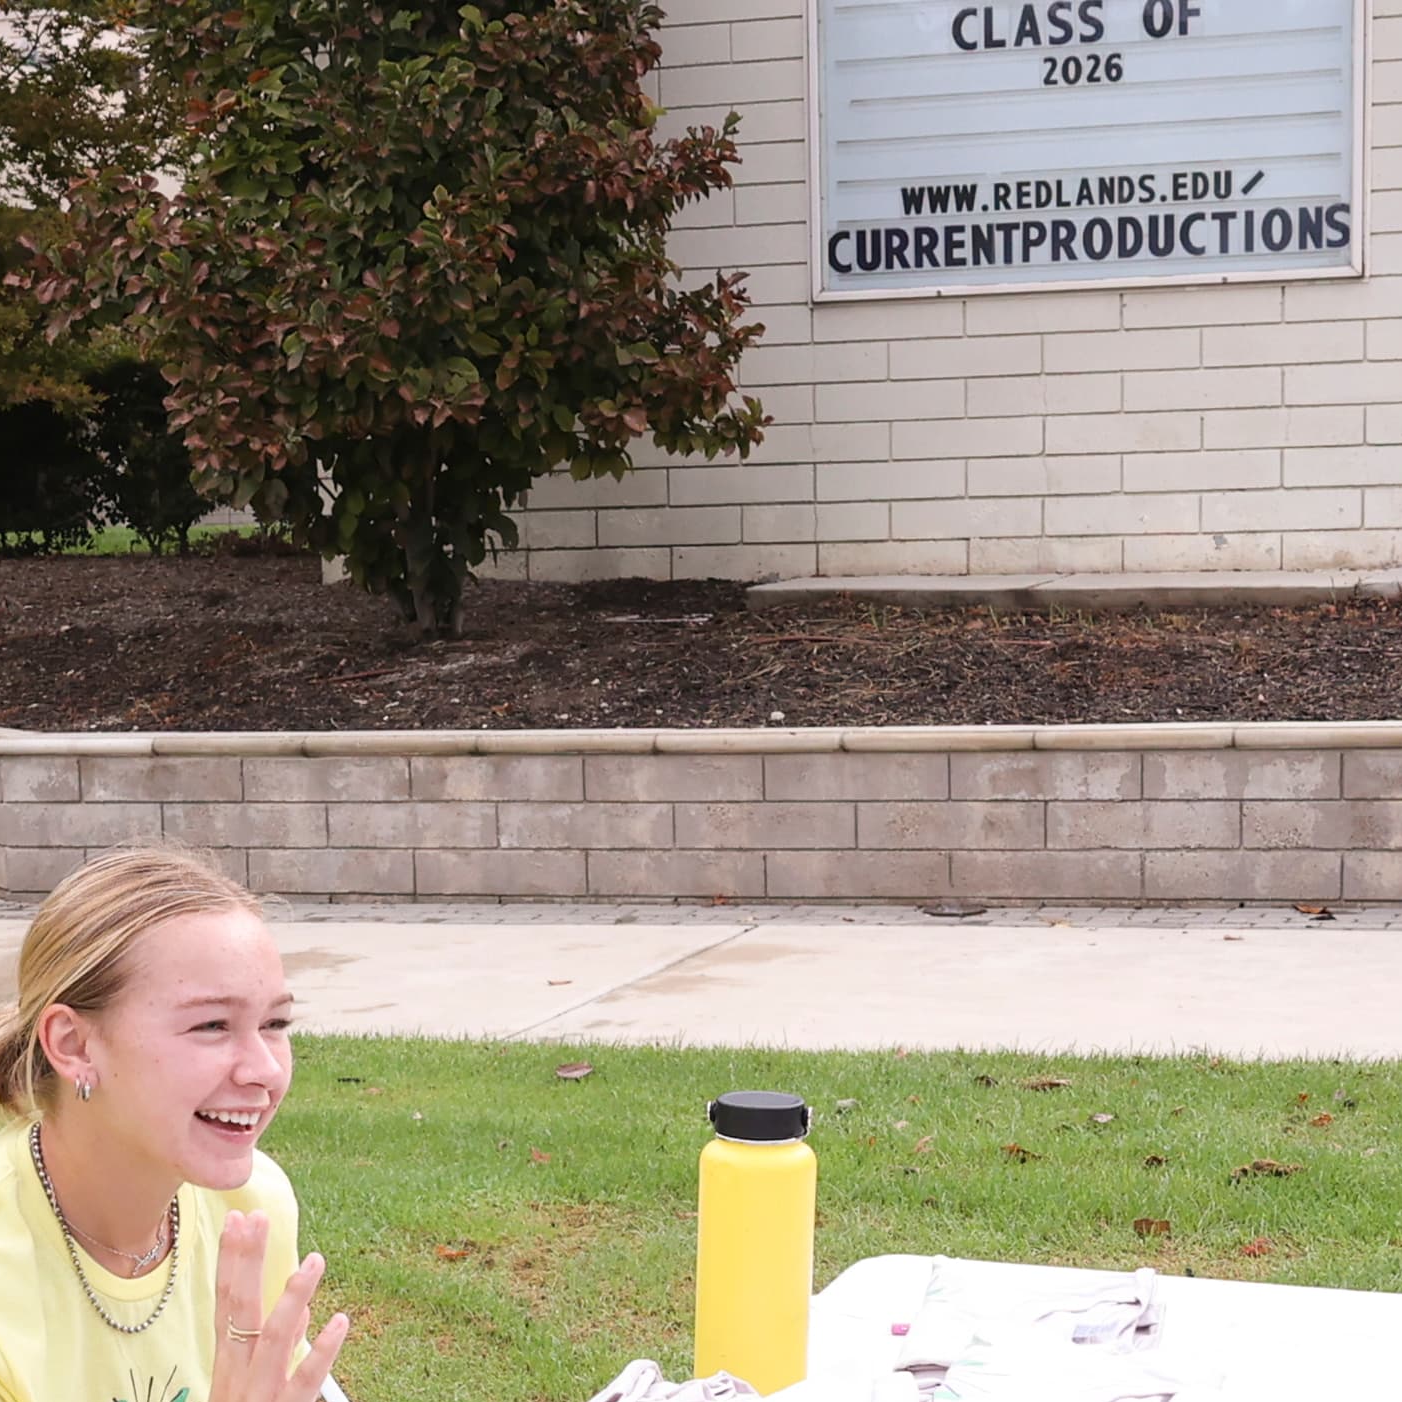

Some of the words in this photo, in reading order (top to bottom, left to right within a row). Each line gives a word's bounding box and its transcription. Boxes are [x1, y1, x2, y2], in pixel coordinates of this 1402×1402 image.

[951, 0, 1106, 52] CLASS
[1142, 0, 1203, 40] OF
[1042, 53, 1124, 86] 2026
[901, 170, 1265, 215] WWW.REDLANDS.EDU/
[828, 203, 1352, 275] CURRENTPRODUCTIONS
